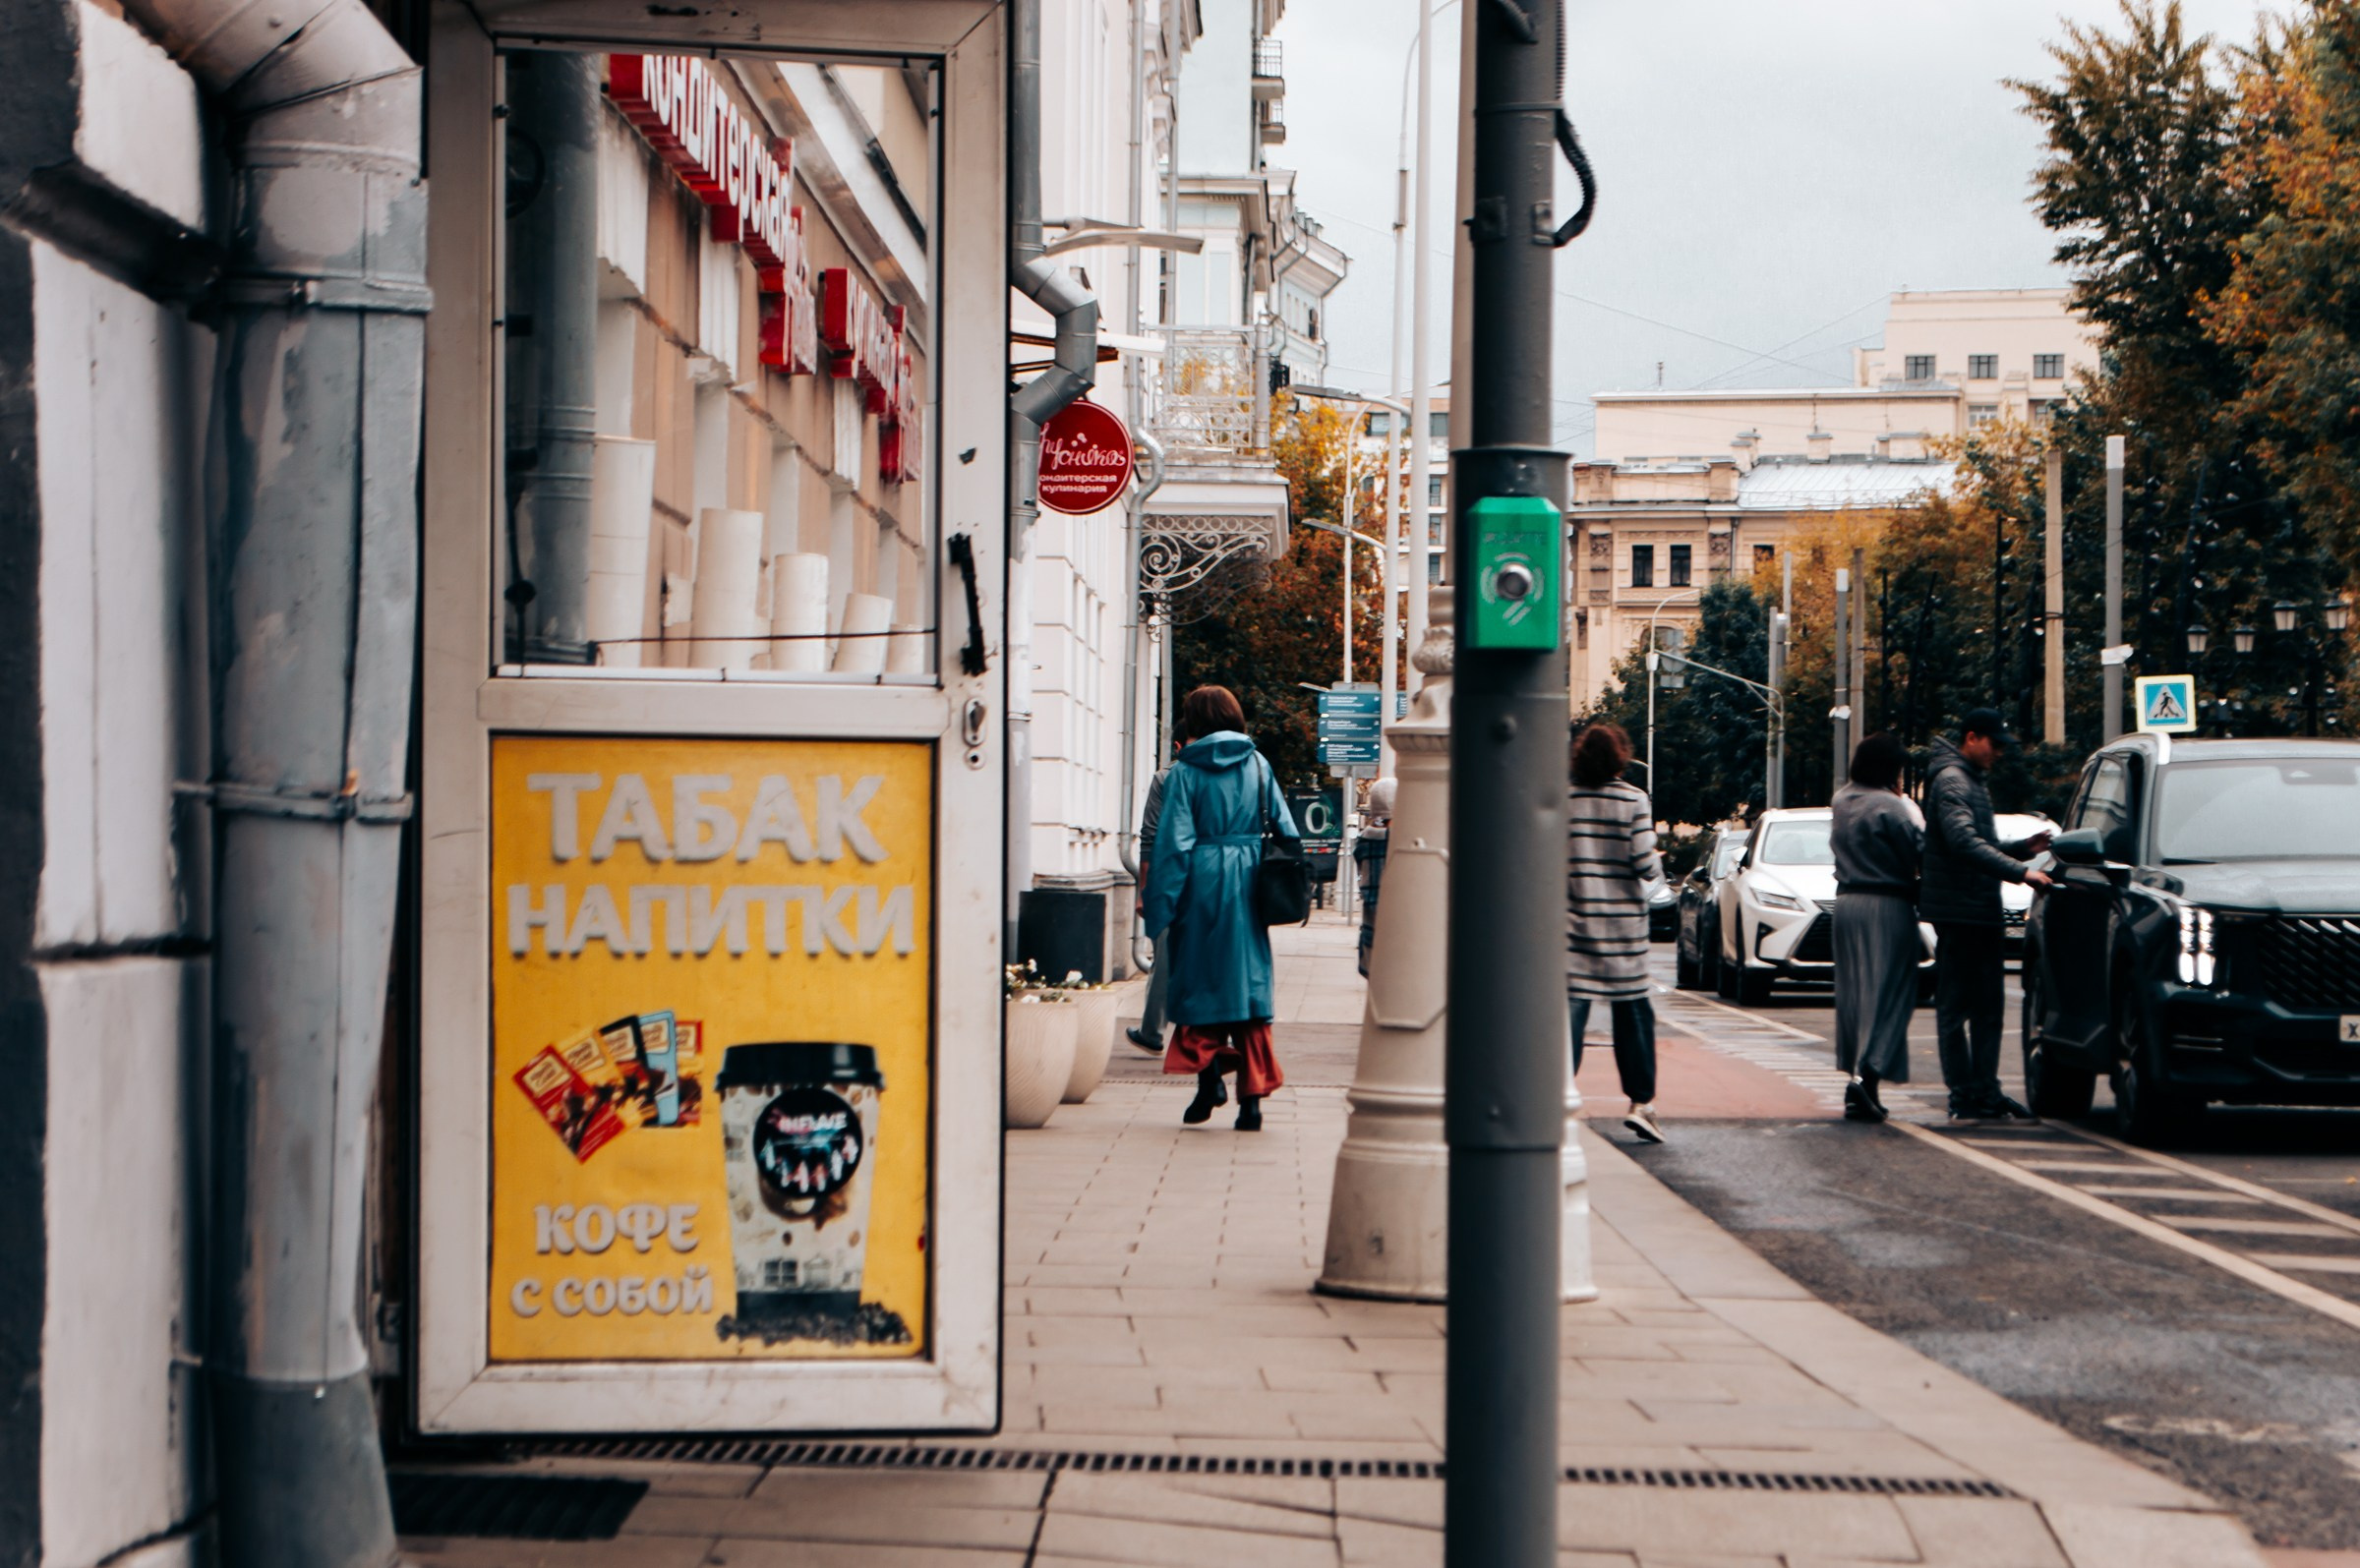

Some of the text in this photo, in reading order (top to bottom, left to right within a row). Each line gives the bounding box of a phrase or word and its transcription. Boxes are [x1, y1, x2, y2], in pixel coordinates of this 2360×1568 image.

[1038, 474, 1118, 484] ондитерская
[1041, 484, 1107, 494] кулинария
[526, 772, 892, 862] ТАБАК
[506, 884, 917, 957] НАПИТКИ
[534, 1202, 701, 1255] КОФЕ
[552, 1263, 714, 1317] СОБОЙ
